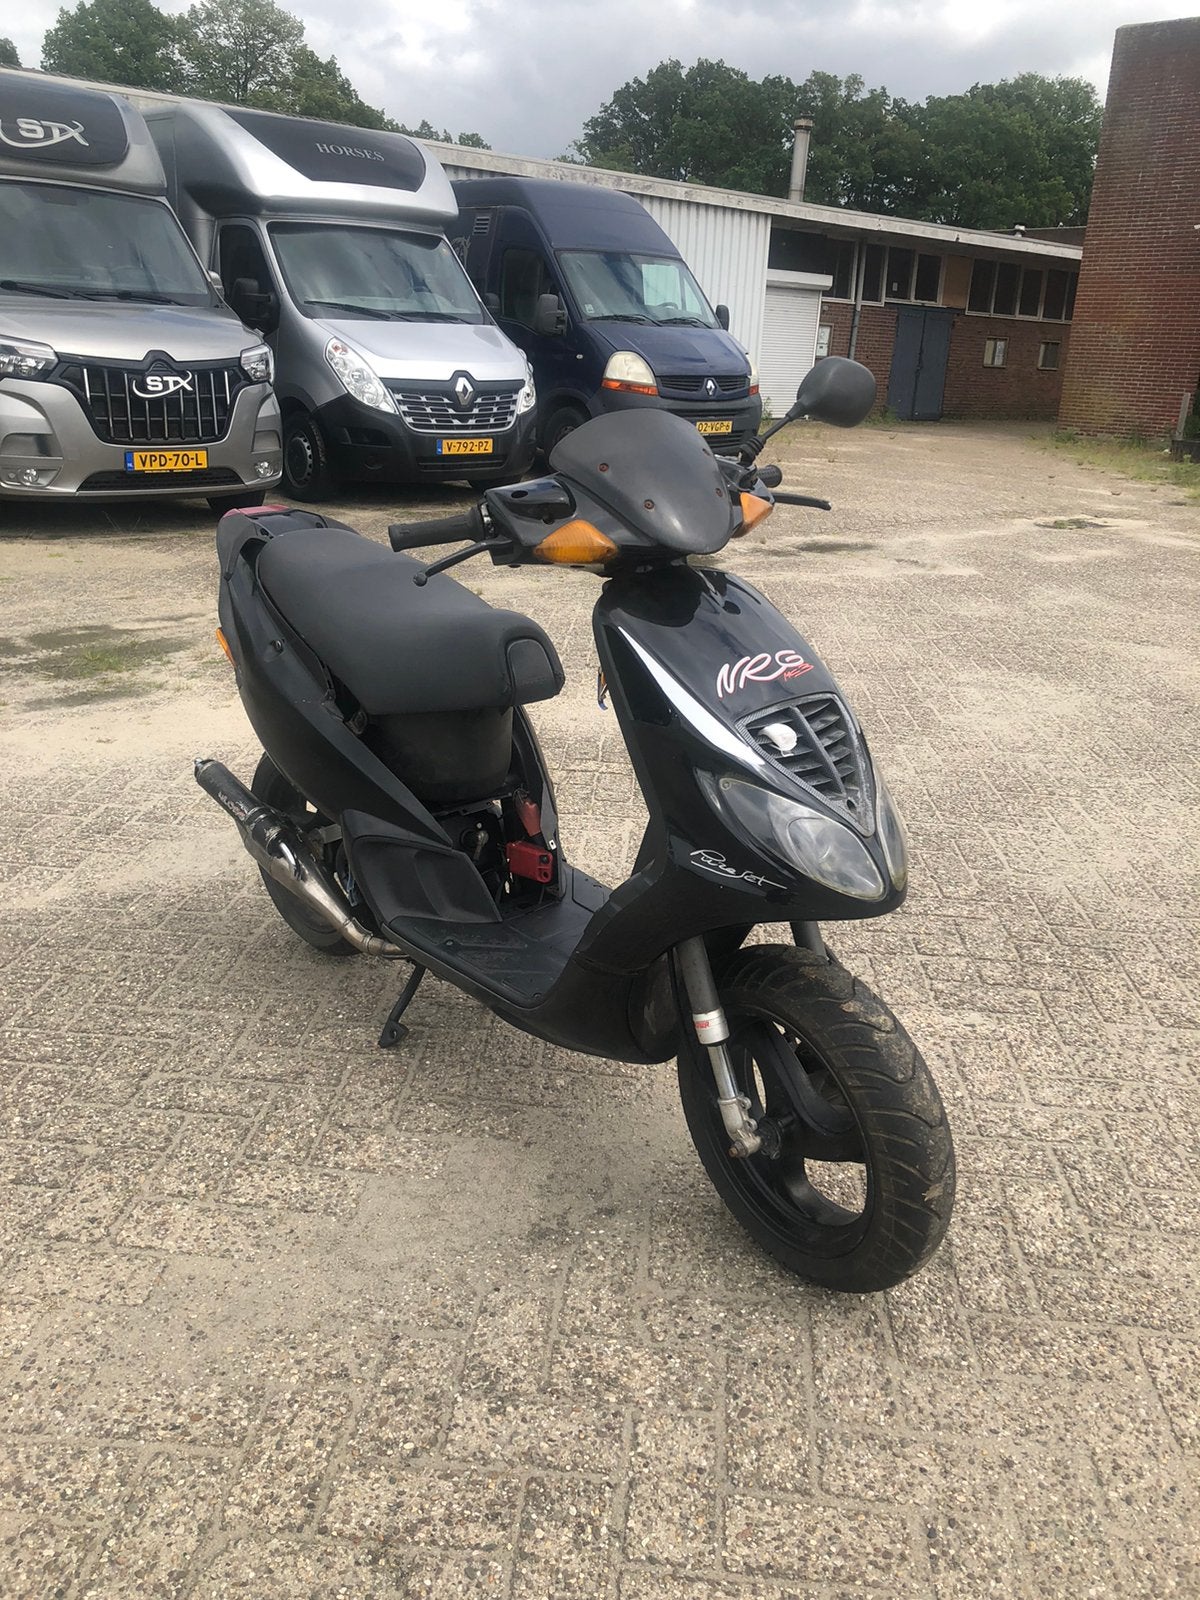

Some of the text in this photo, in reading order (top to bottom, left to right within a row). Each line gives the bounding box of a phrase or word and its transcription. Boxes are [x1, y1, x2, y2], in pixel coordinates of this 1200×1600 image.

[315, 142, 385, 161] HORSES
[134, 371, 194, 397] STX
[697, 422, 731, 432] 02-VGP-6
[446, 441, 489, 452] V-792-PZ
[139, 453, 203, 467] VPD-70-L
[716, 649, 805, 698] NRG
